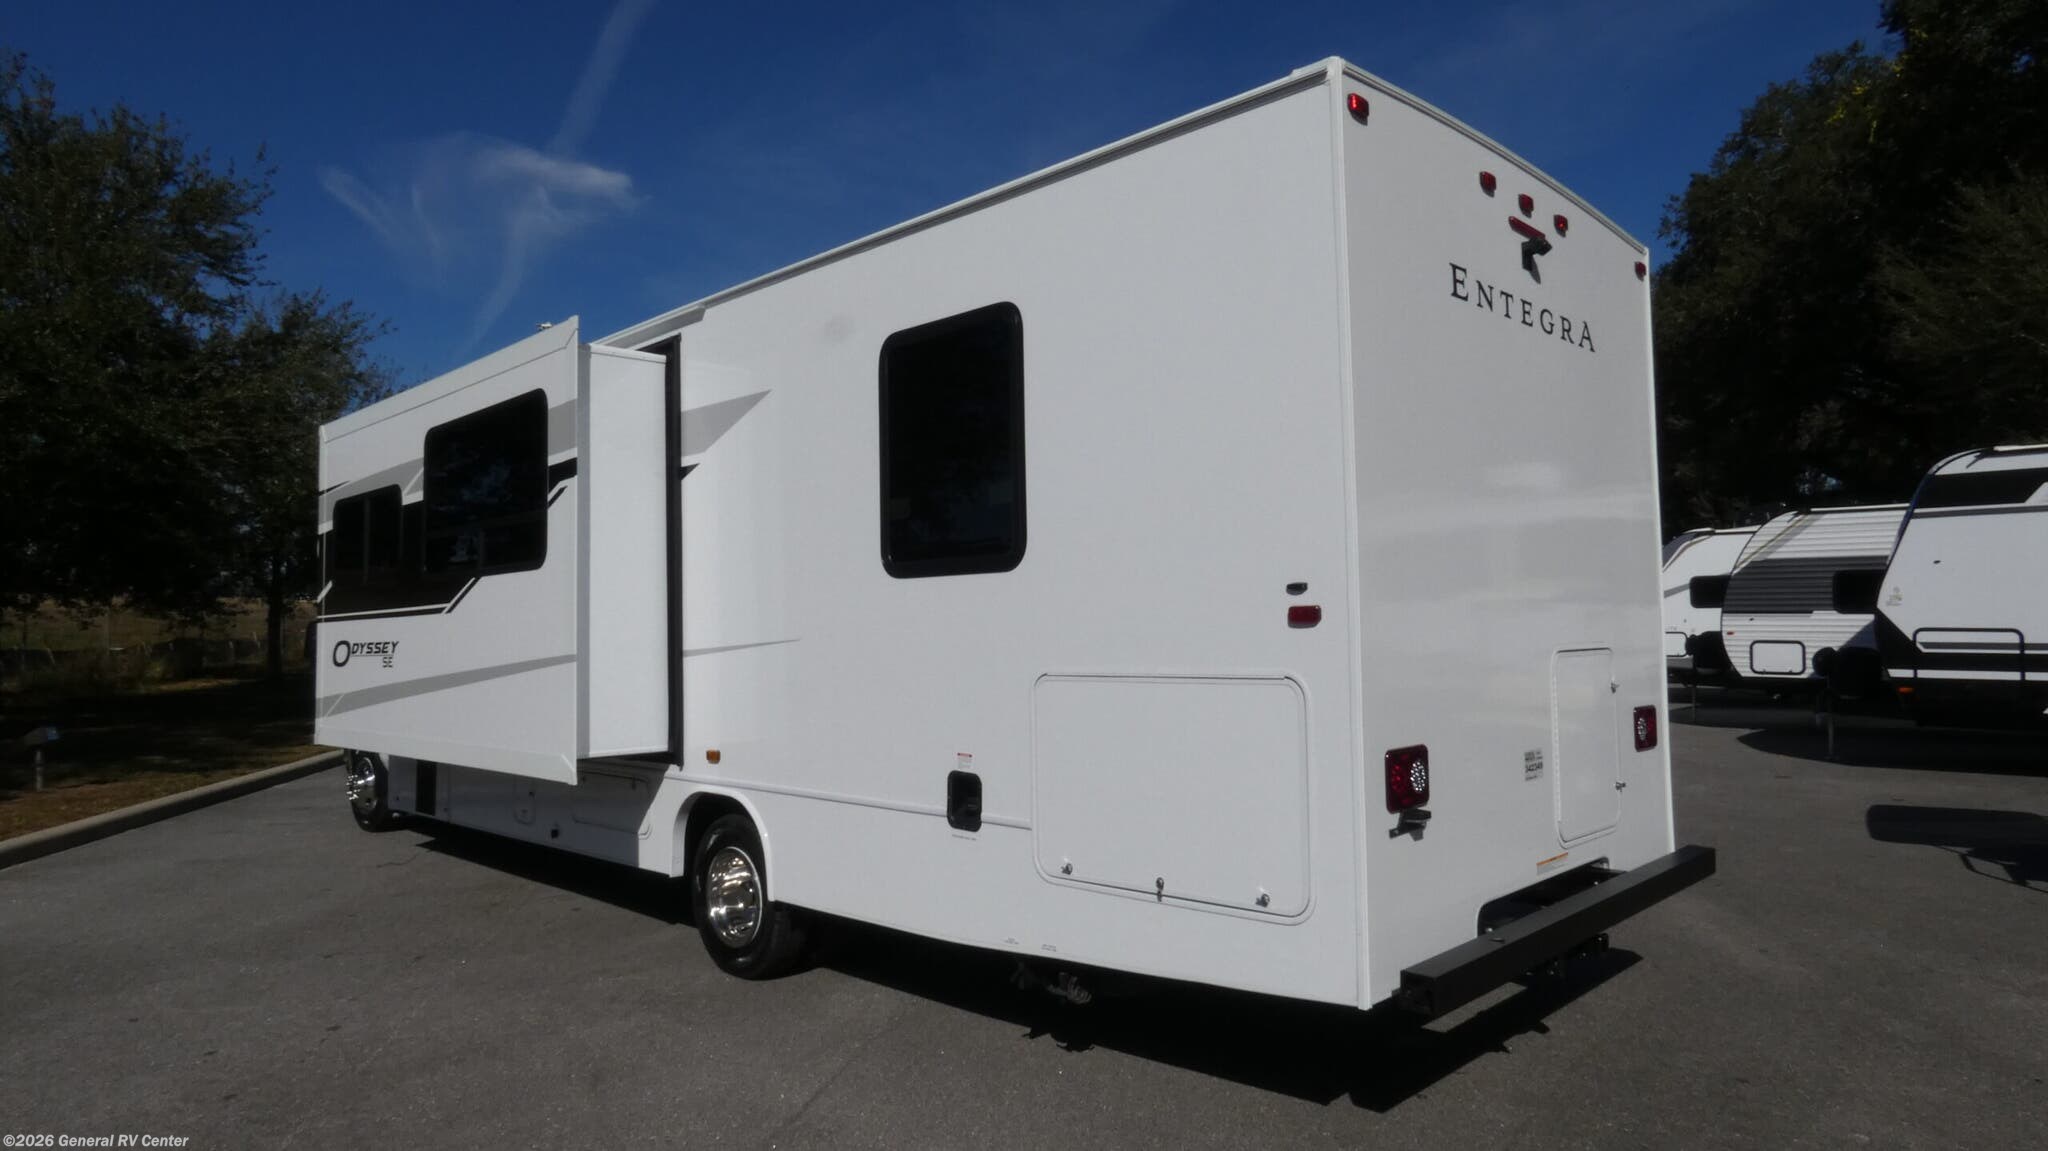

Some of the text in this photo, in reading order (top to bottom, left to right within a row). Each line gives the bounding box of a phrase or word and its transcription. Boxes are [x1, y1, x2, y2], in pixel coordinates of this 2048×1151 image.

[1449, 262, 1596, 353] ENTEGRA
[333, 640, 399, 668] ODYSSEY
[382, 656, 393, 668] SE
